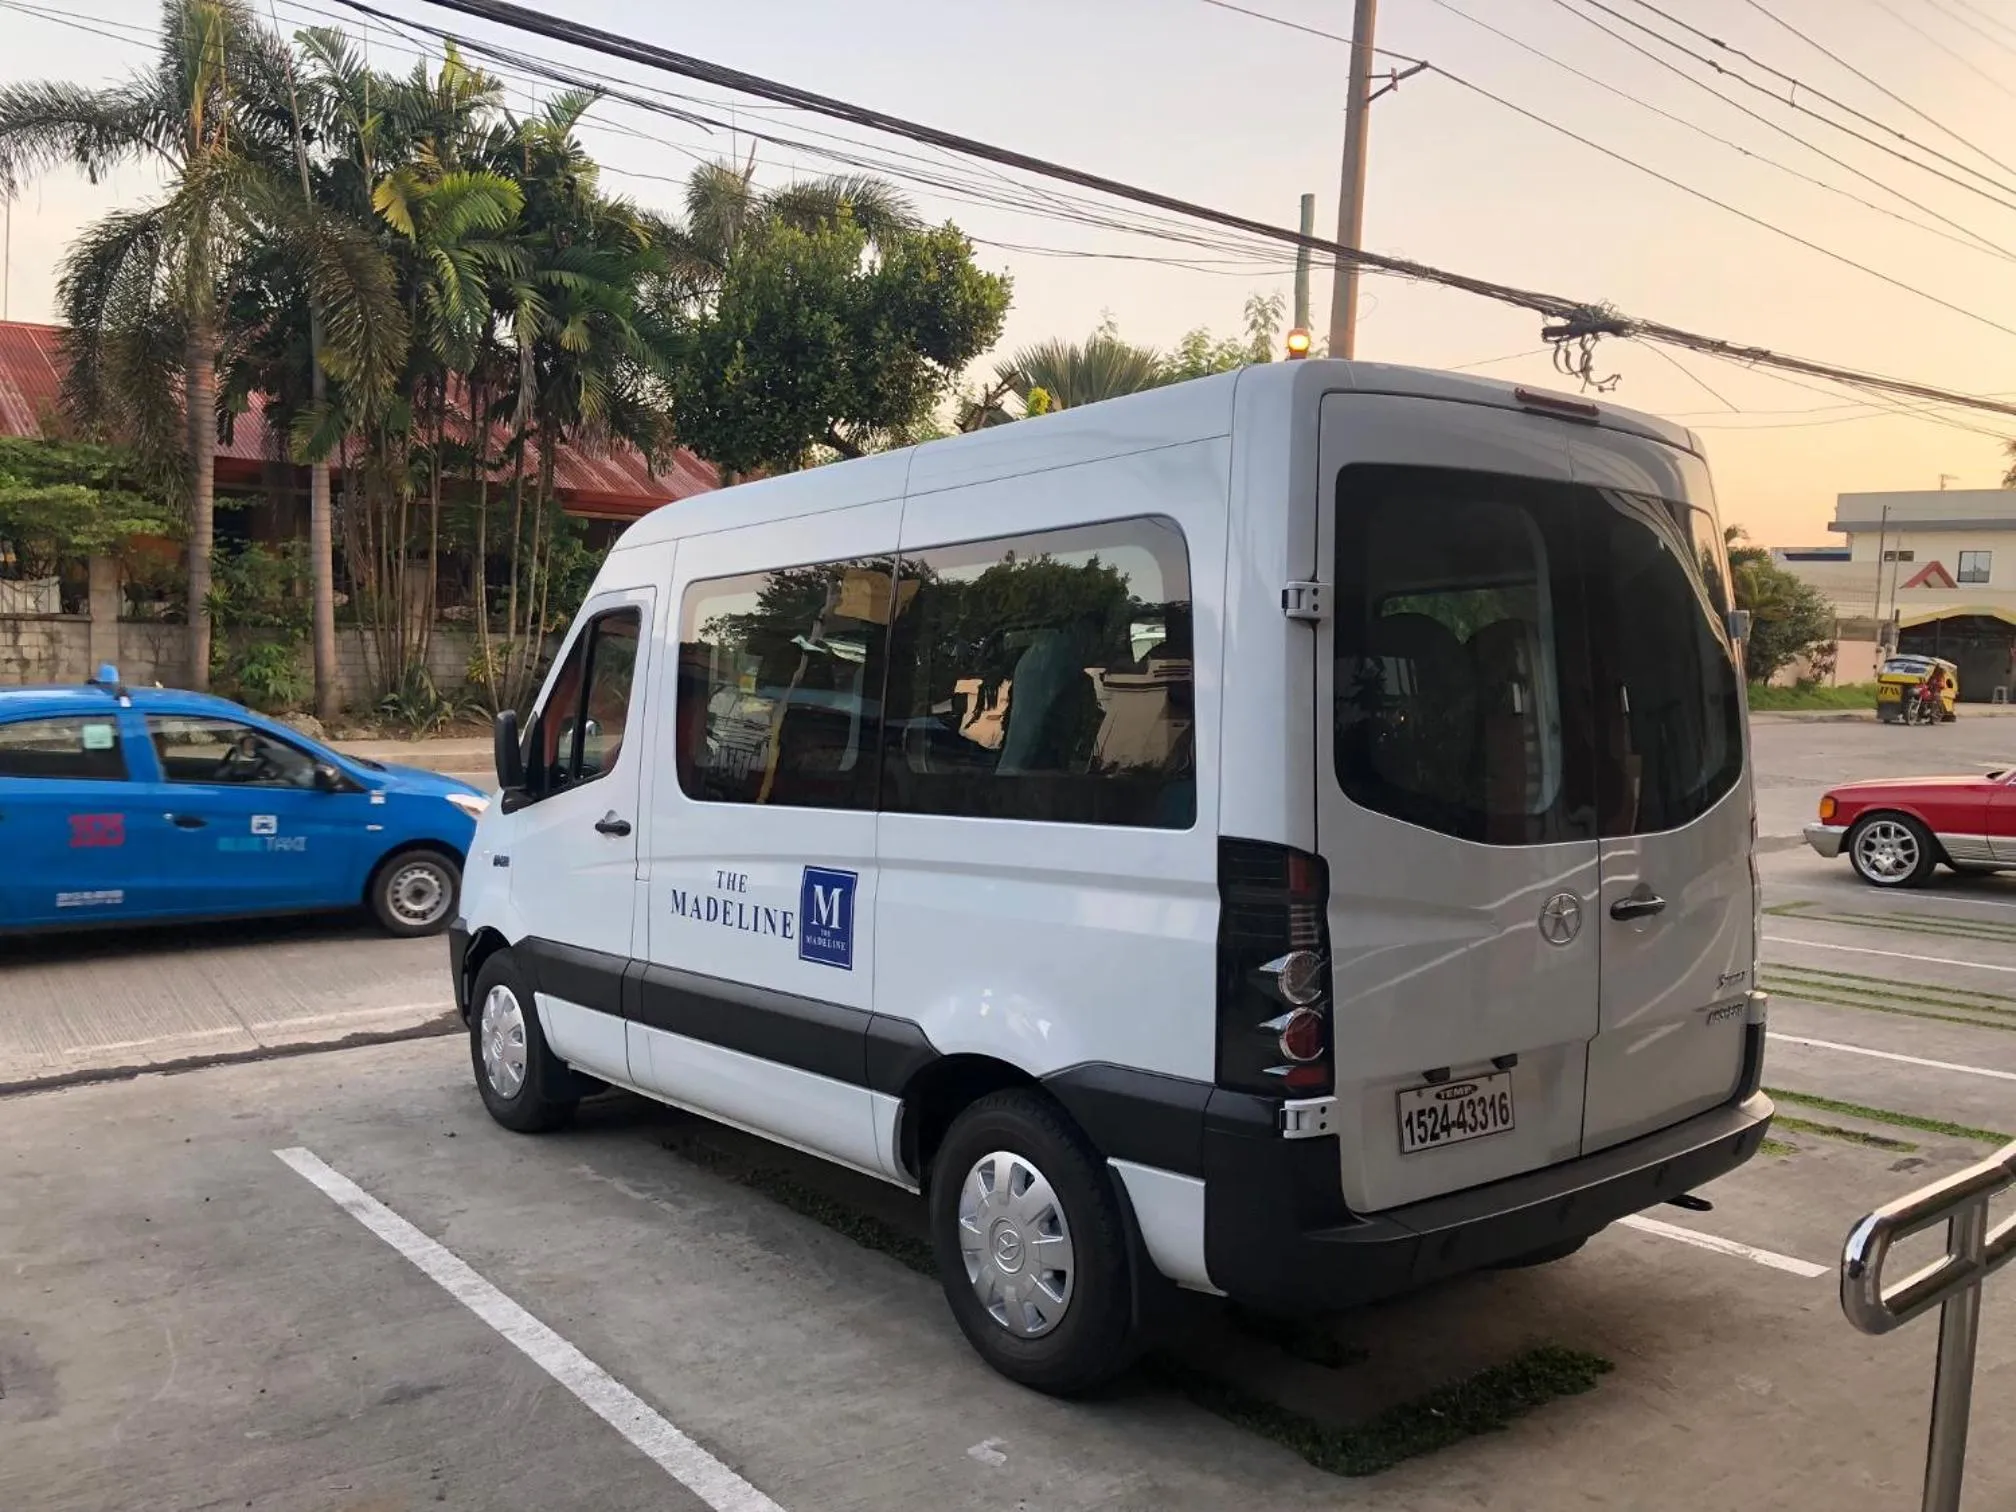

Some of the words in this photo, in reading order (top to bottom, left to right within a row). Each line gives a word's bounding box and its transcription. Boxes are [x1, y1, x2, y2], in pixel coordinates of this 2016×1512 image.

[717, 870, 748, 893] THE
[670, 889, 794, 939] MADELINE
[810, 884, 844, 929] M
[806, 935, 846, 951] MADELINE
[1405, 1092, 1510, 1146] 1524-43316
